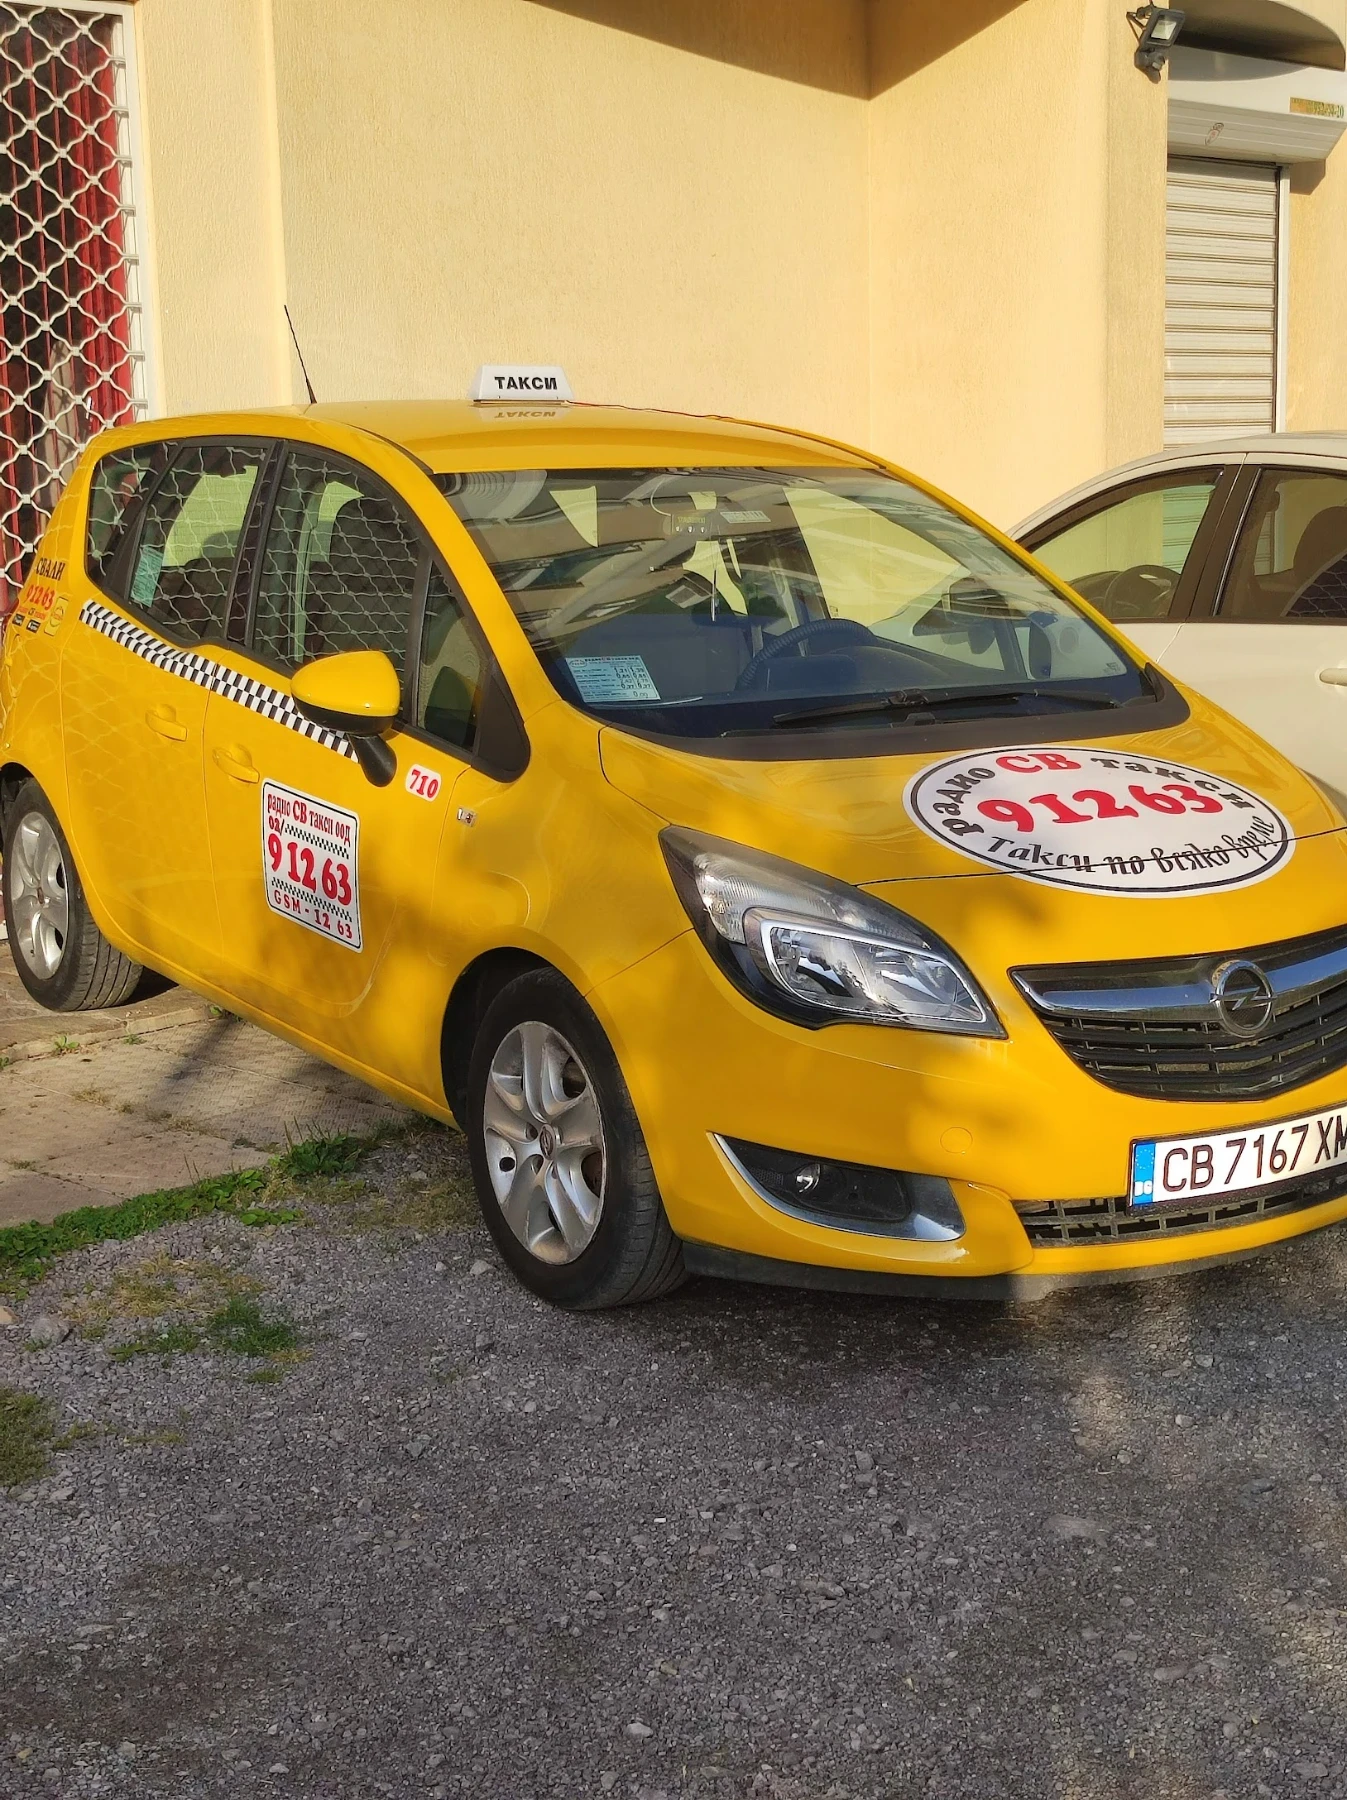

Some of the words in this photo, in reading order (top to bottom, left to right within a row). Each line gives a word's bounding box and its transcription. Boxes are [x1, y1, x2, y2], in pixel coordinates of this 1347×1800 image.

[494, 376, 558, 391] ТАКСИ
[410, 769, 438, 798] 710
[932, 766, 996, 837] радио
[995, 753, 1082, 774] СВ
[1090, 757, 1256, 811] такси
[267, 793, 291, 818] радио
[309, 810, 334, 835] такси
[987, 836, 1097, 875] Такси
[1103, 854, 1145, 875] по
[274, 889, 302, 914] GSM
